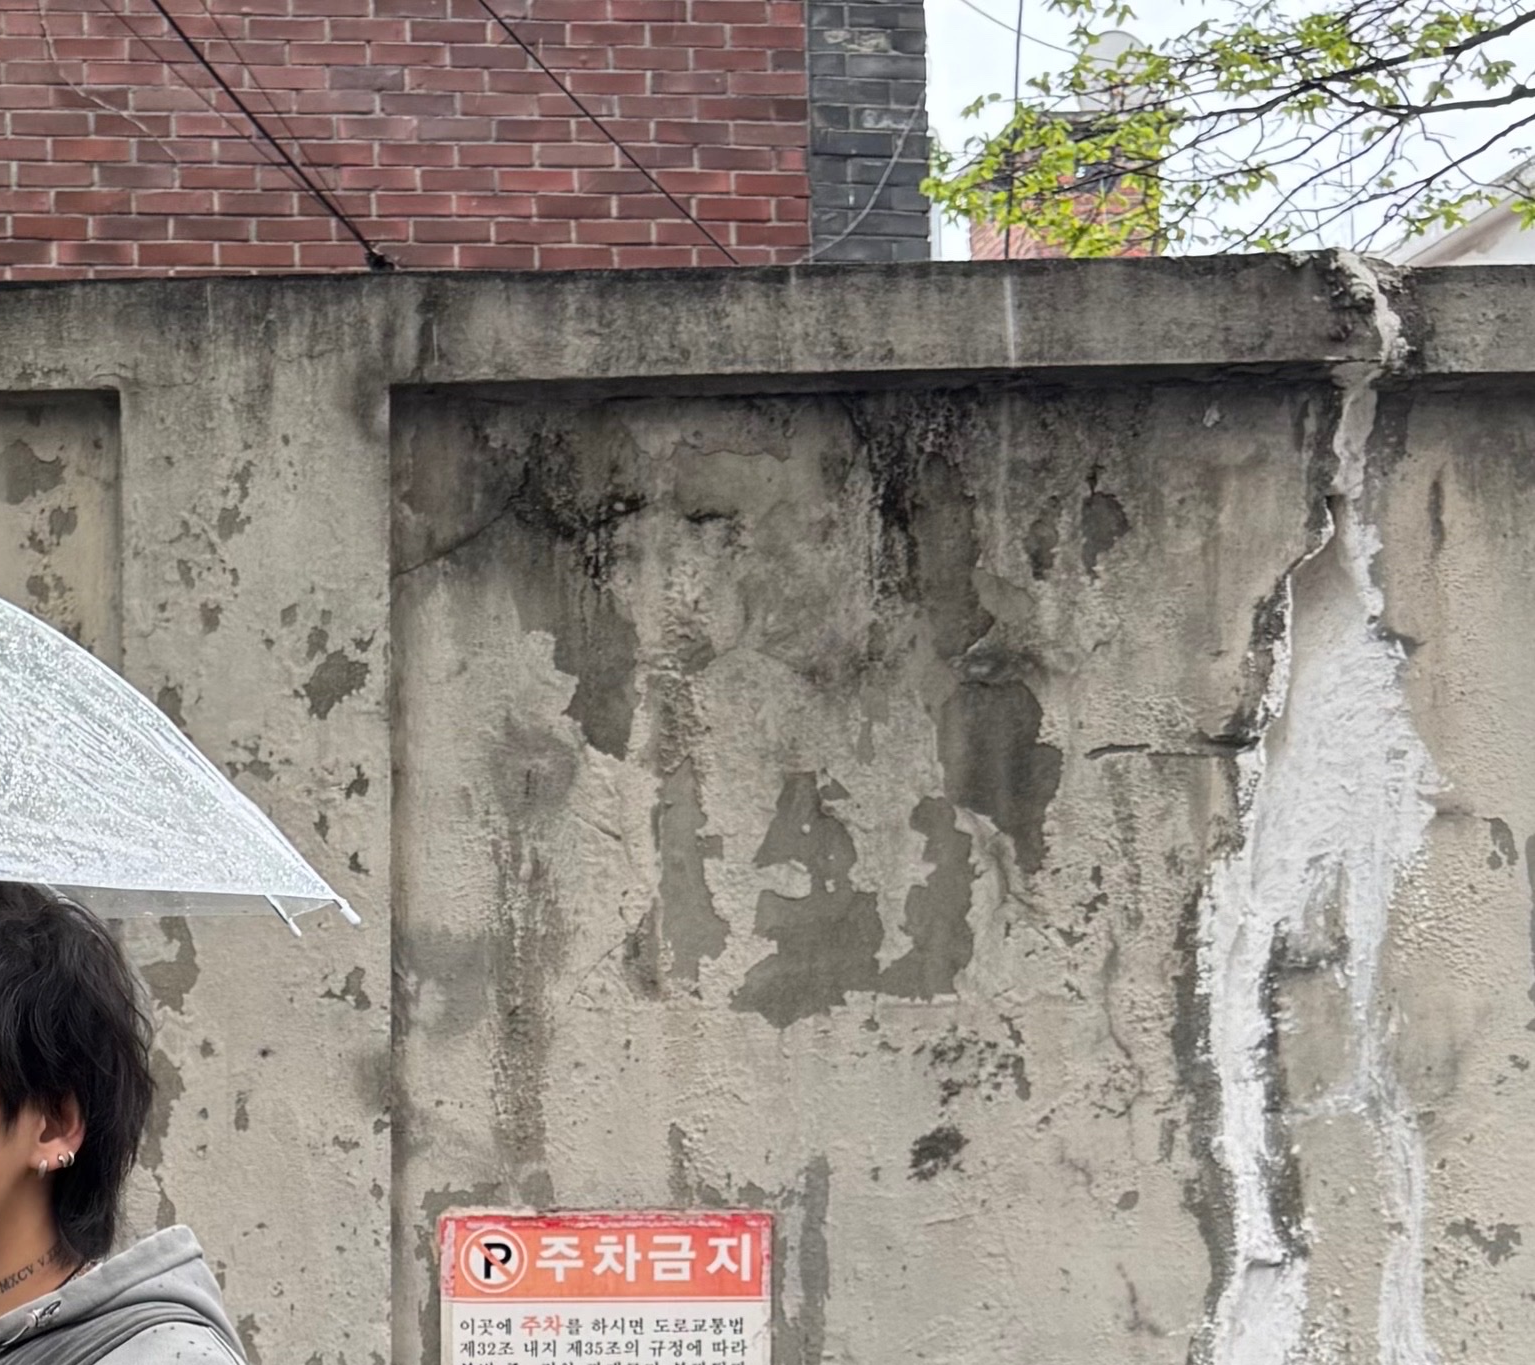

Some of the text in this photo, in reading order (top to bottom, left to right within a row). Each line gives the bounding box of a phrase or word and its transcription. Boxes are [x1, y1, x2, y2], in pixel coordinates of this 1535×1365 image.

[535, 1233, 752, 1283] 주차금지
[459, 1314, 745, 1337] 이곳에 주차를 하시면 도로교통법
[459, 1338, 748, 1358] 제32조 내지 제35조의 규정에 따라
